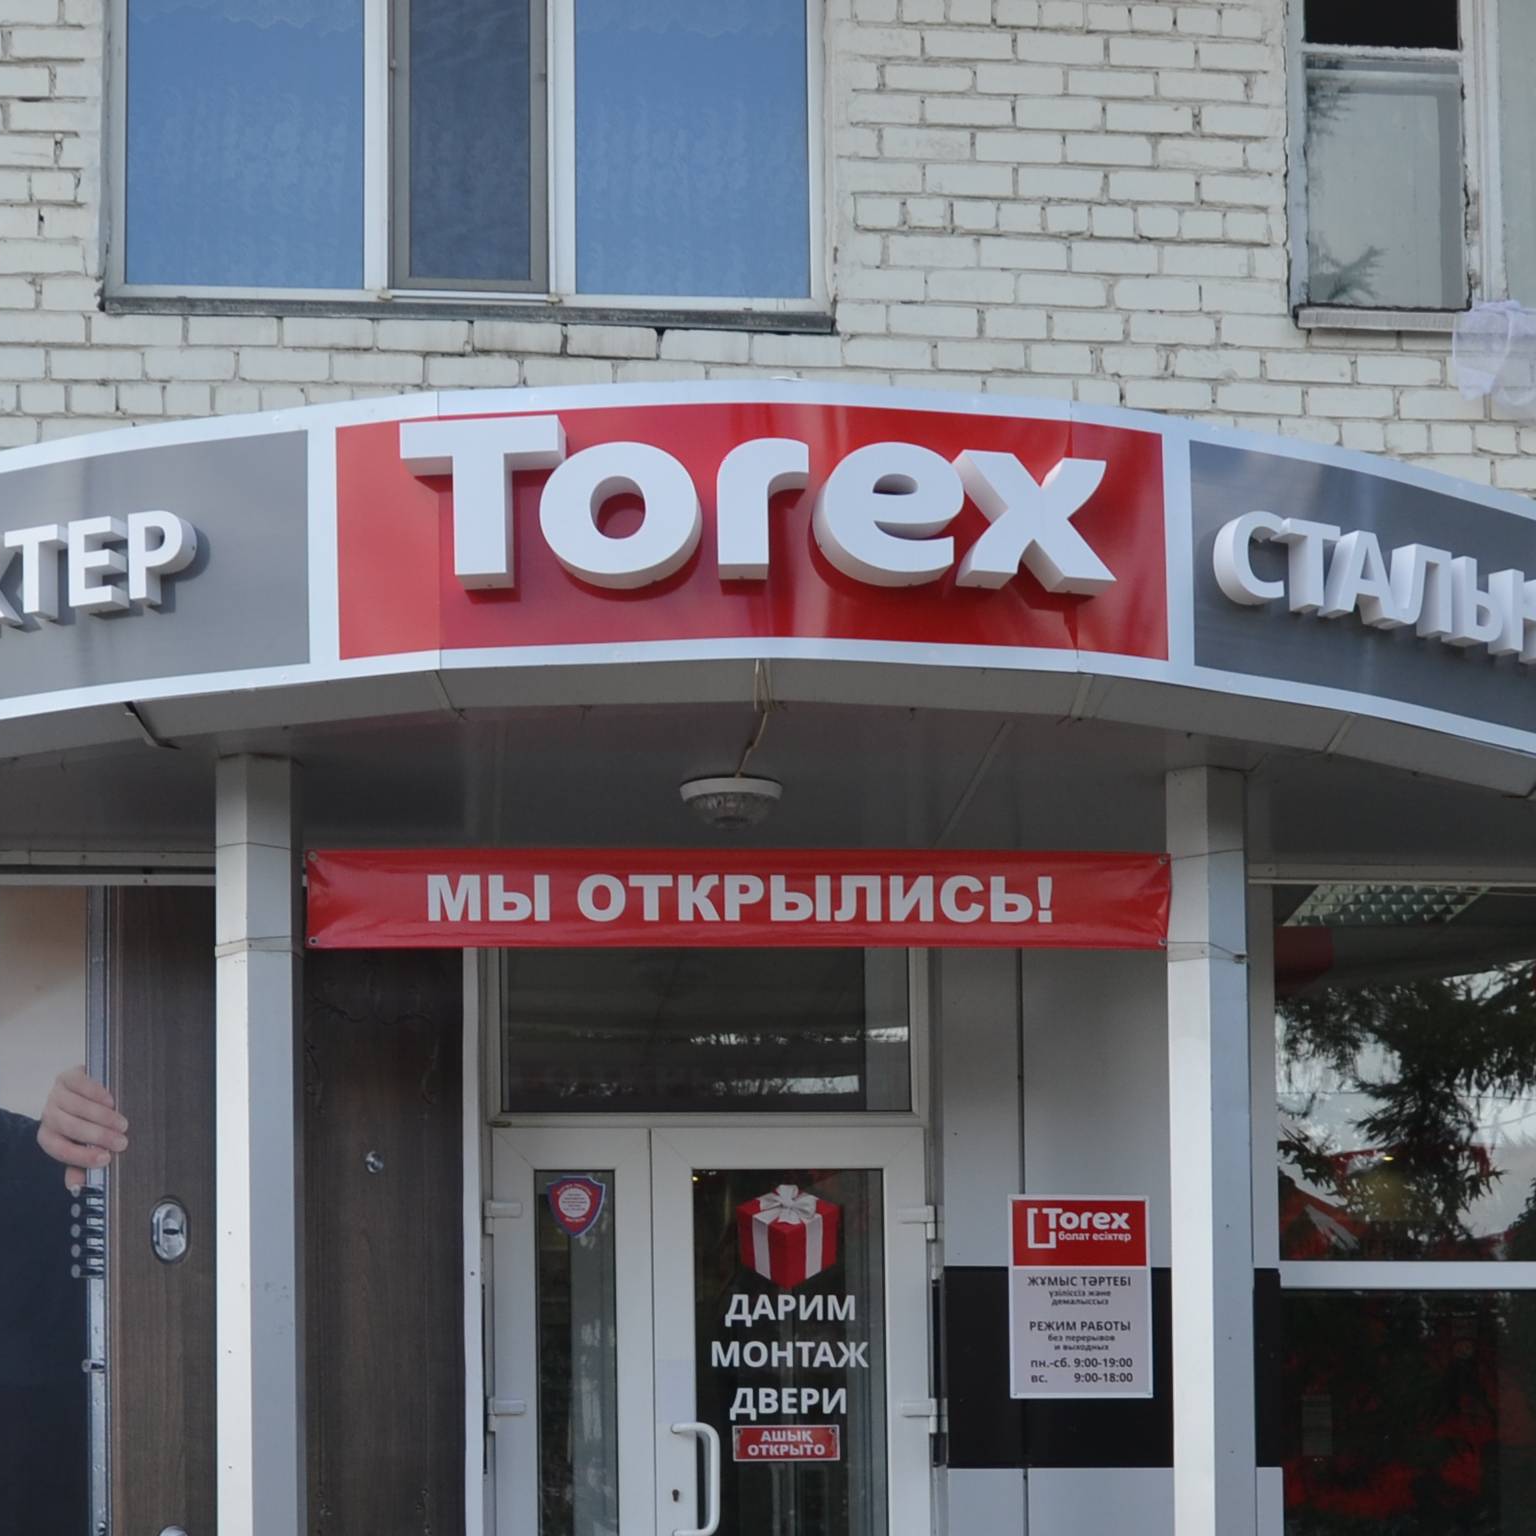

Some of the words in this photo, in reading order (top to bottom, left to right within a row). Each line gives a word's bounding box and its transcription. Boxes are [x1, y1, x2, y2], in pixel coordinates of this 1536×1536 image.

[400, 414, 1117, 595] Torex
[426, 875, 550, 922] МЫ
[576, 873, 1054, 924] ОТКРЫЛИСЬ!
[1042, 1207, 1131, 1230] Torex
[1058, 1231, 1090, 1241] болат
[724, 1294, 856, 1327] ДАРИМ
[1029, 1321, 1077, 1332] РЕЖИМ
[1080, 1321, 1131, 1332] РАБОТЫ
[1048, 1334, 1063, 1342] без
[1065, 1335, 1115, 1343] перерывов
[1062, 1344, 1109, 1352] выходных
[711, 1341, 869, 1368] МОНТАЖ
[1073, 1357, 1133, 1368] 9:00-19:00
[1030, 1374, 1048, 1383] вс.
[1074, 1372, 1133, 1383] 9:00-18:00
[729, 1387, 847, 1421] ДВЕРИ
[747, 1444, 825, 1456] ОТКРЫТО
